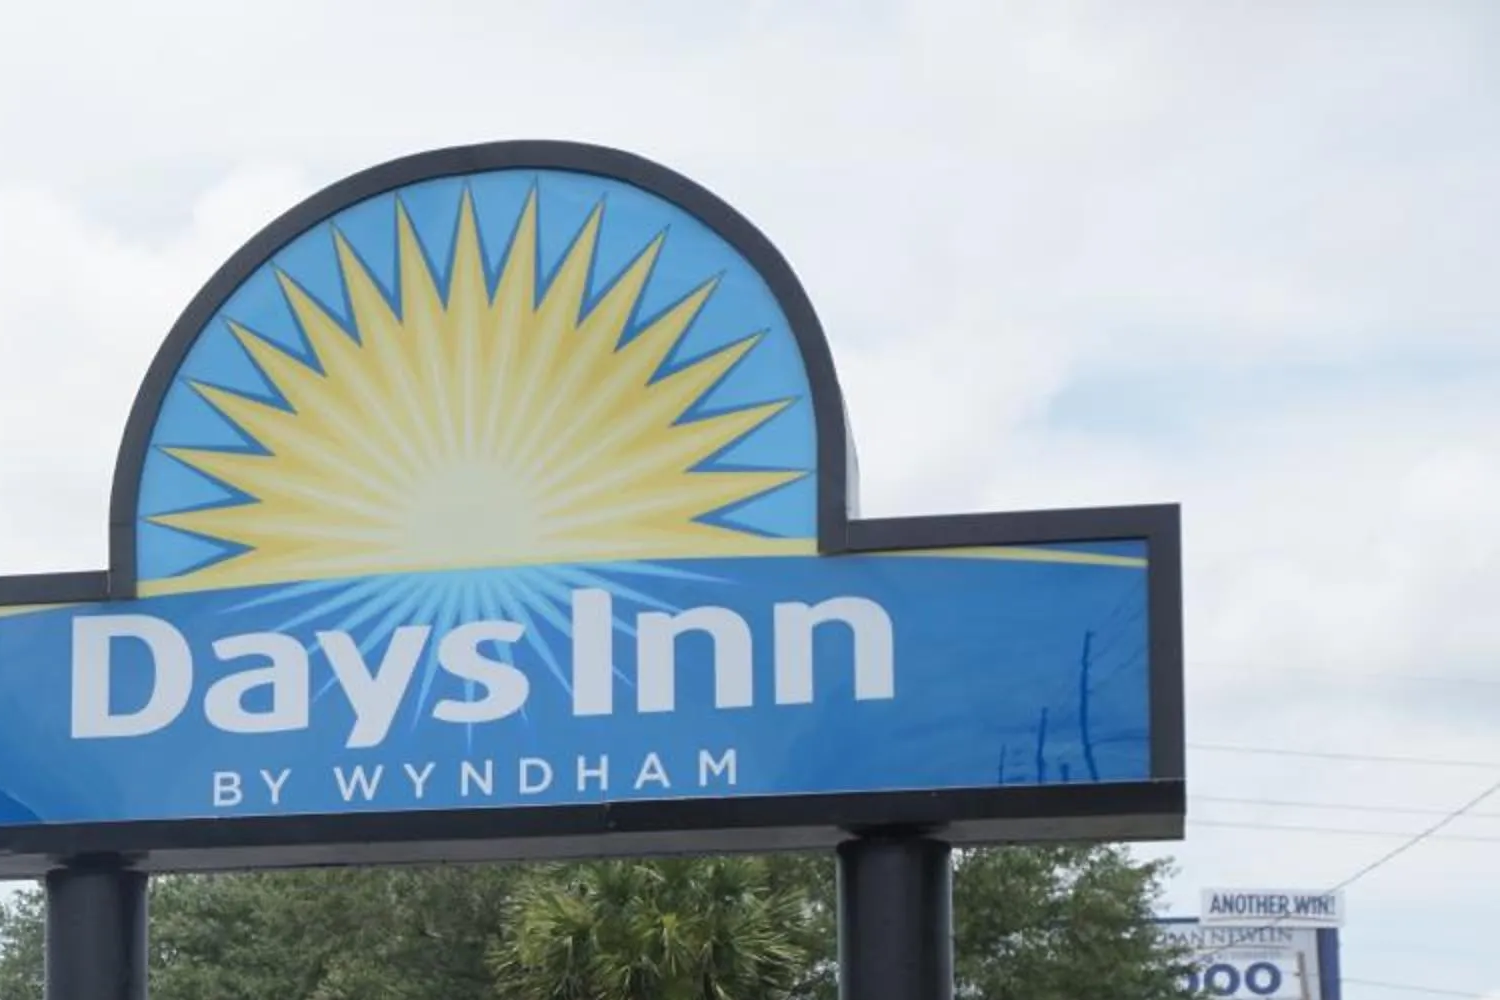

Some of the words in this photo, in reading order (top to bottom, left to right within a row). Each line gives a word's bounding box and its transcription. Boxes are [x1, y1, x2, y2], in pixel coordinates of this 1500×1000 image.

[70, 614, 530, 748] Days
[570, 587, 894, 716] Inn
[213, 768, 292, 807] BY
[333, 748, 737, 802] WYNDHAM
[1209, 893, 1290, 914] ANOTHER
